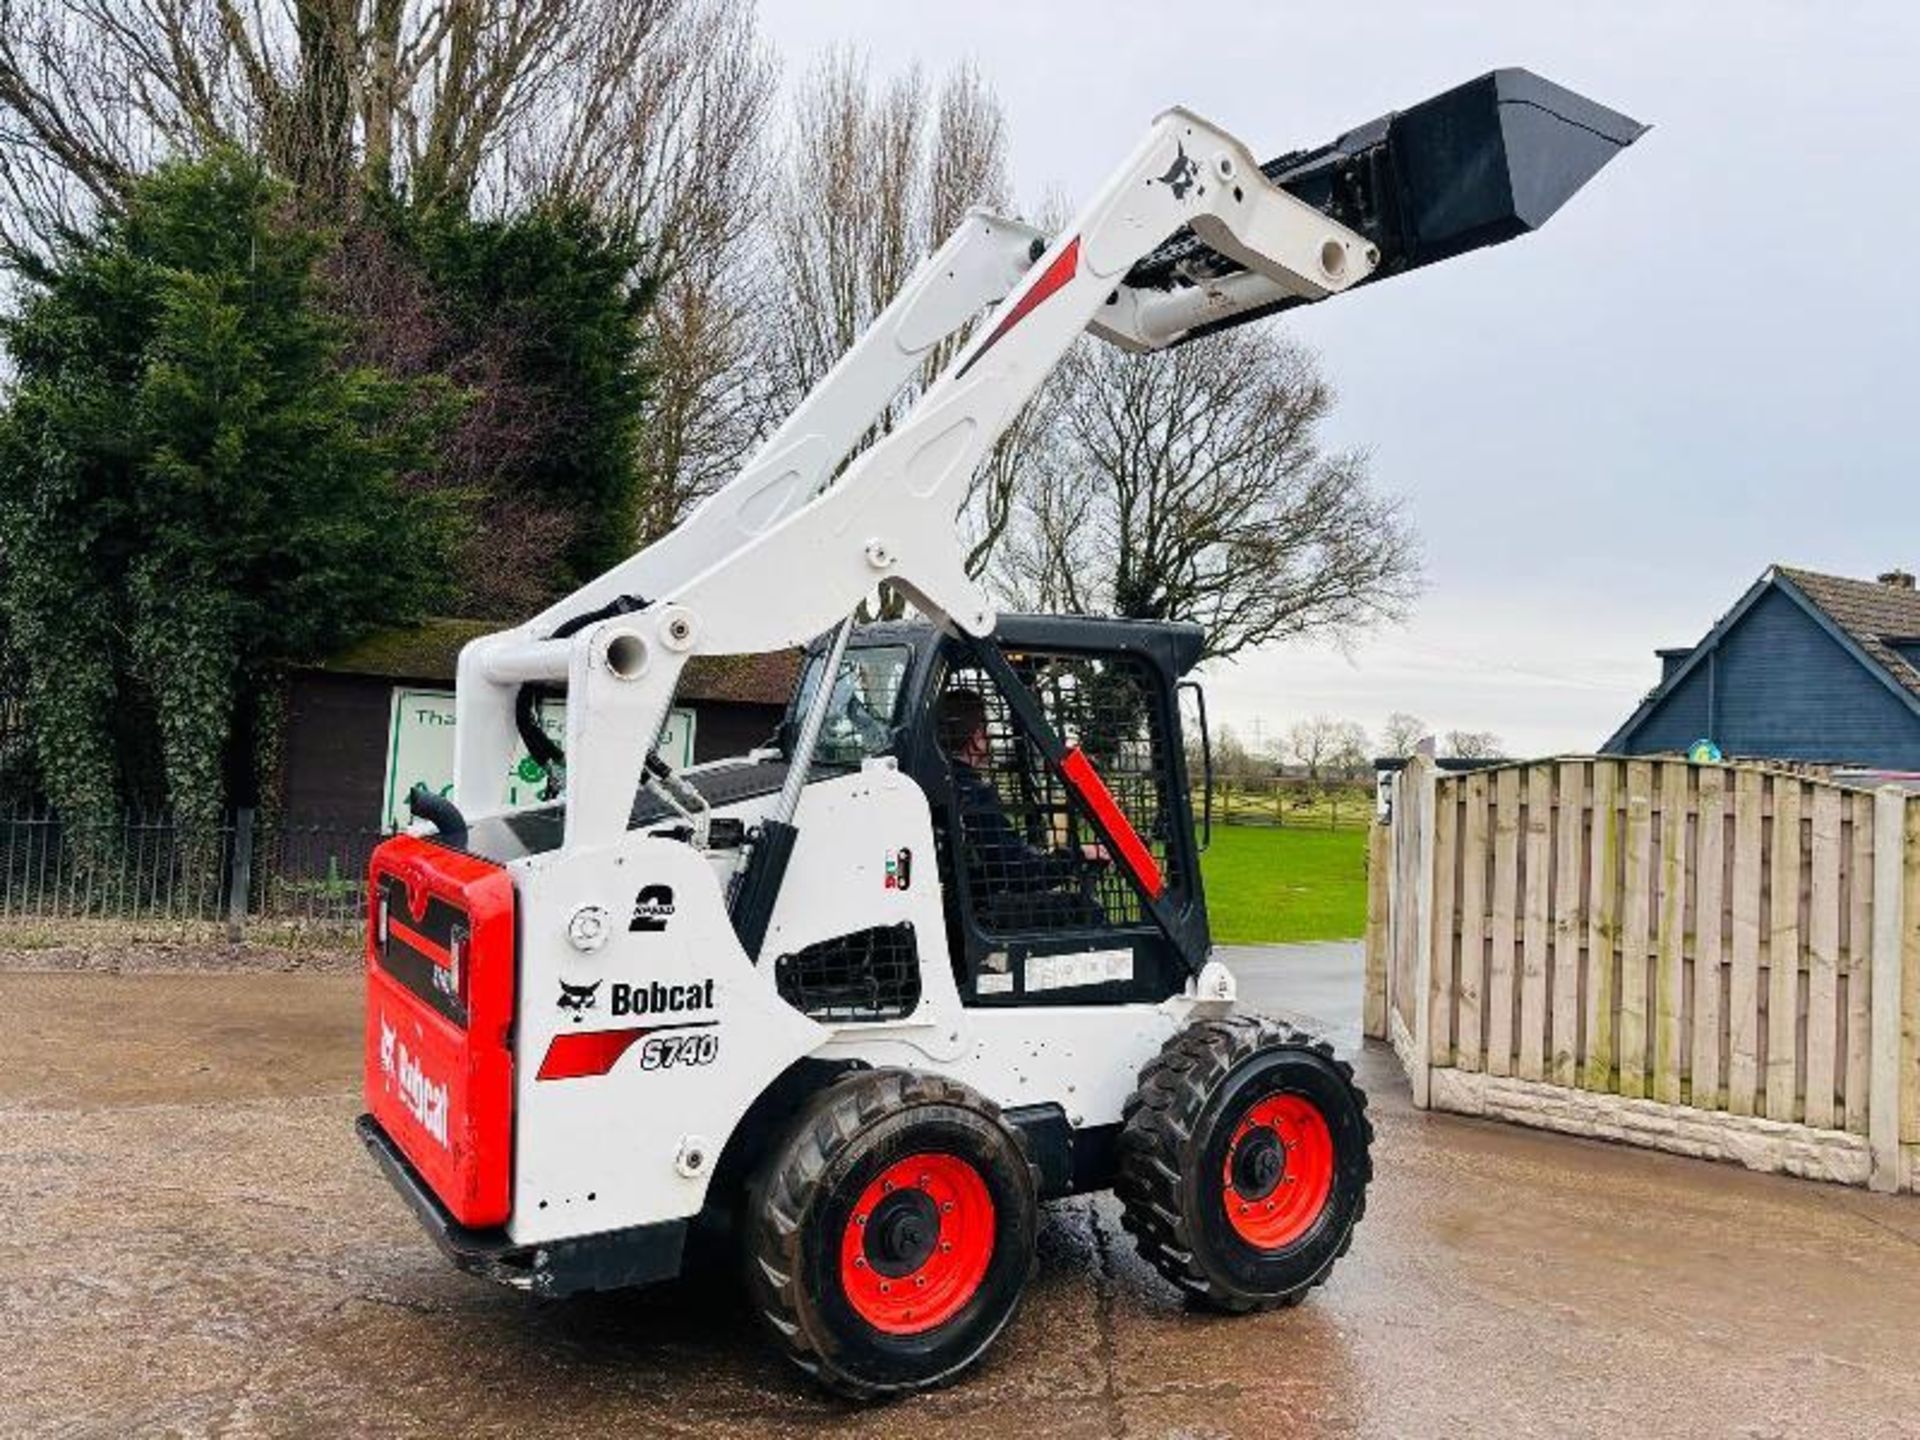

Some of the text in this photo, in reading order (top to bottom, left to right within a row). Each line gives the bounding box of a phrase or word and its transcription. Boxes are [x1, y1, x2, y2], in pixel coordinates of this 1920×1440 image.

[628, 885, 673, 932] 2
[611, 978, 714, 1016] Bobcat
[640, 1034, 718, 1071] S740
[398, 1041, 449, 1148] Bobcat
